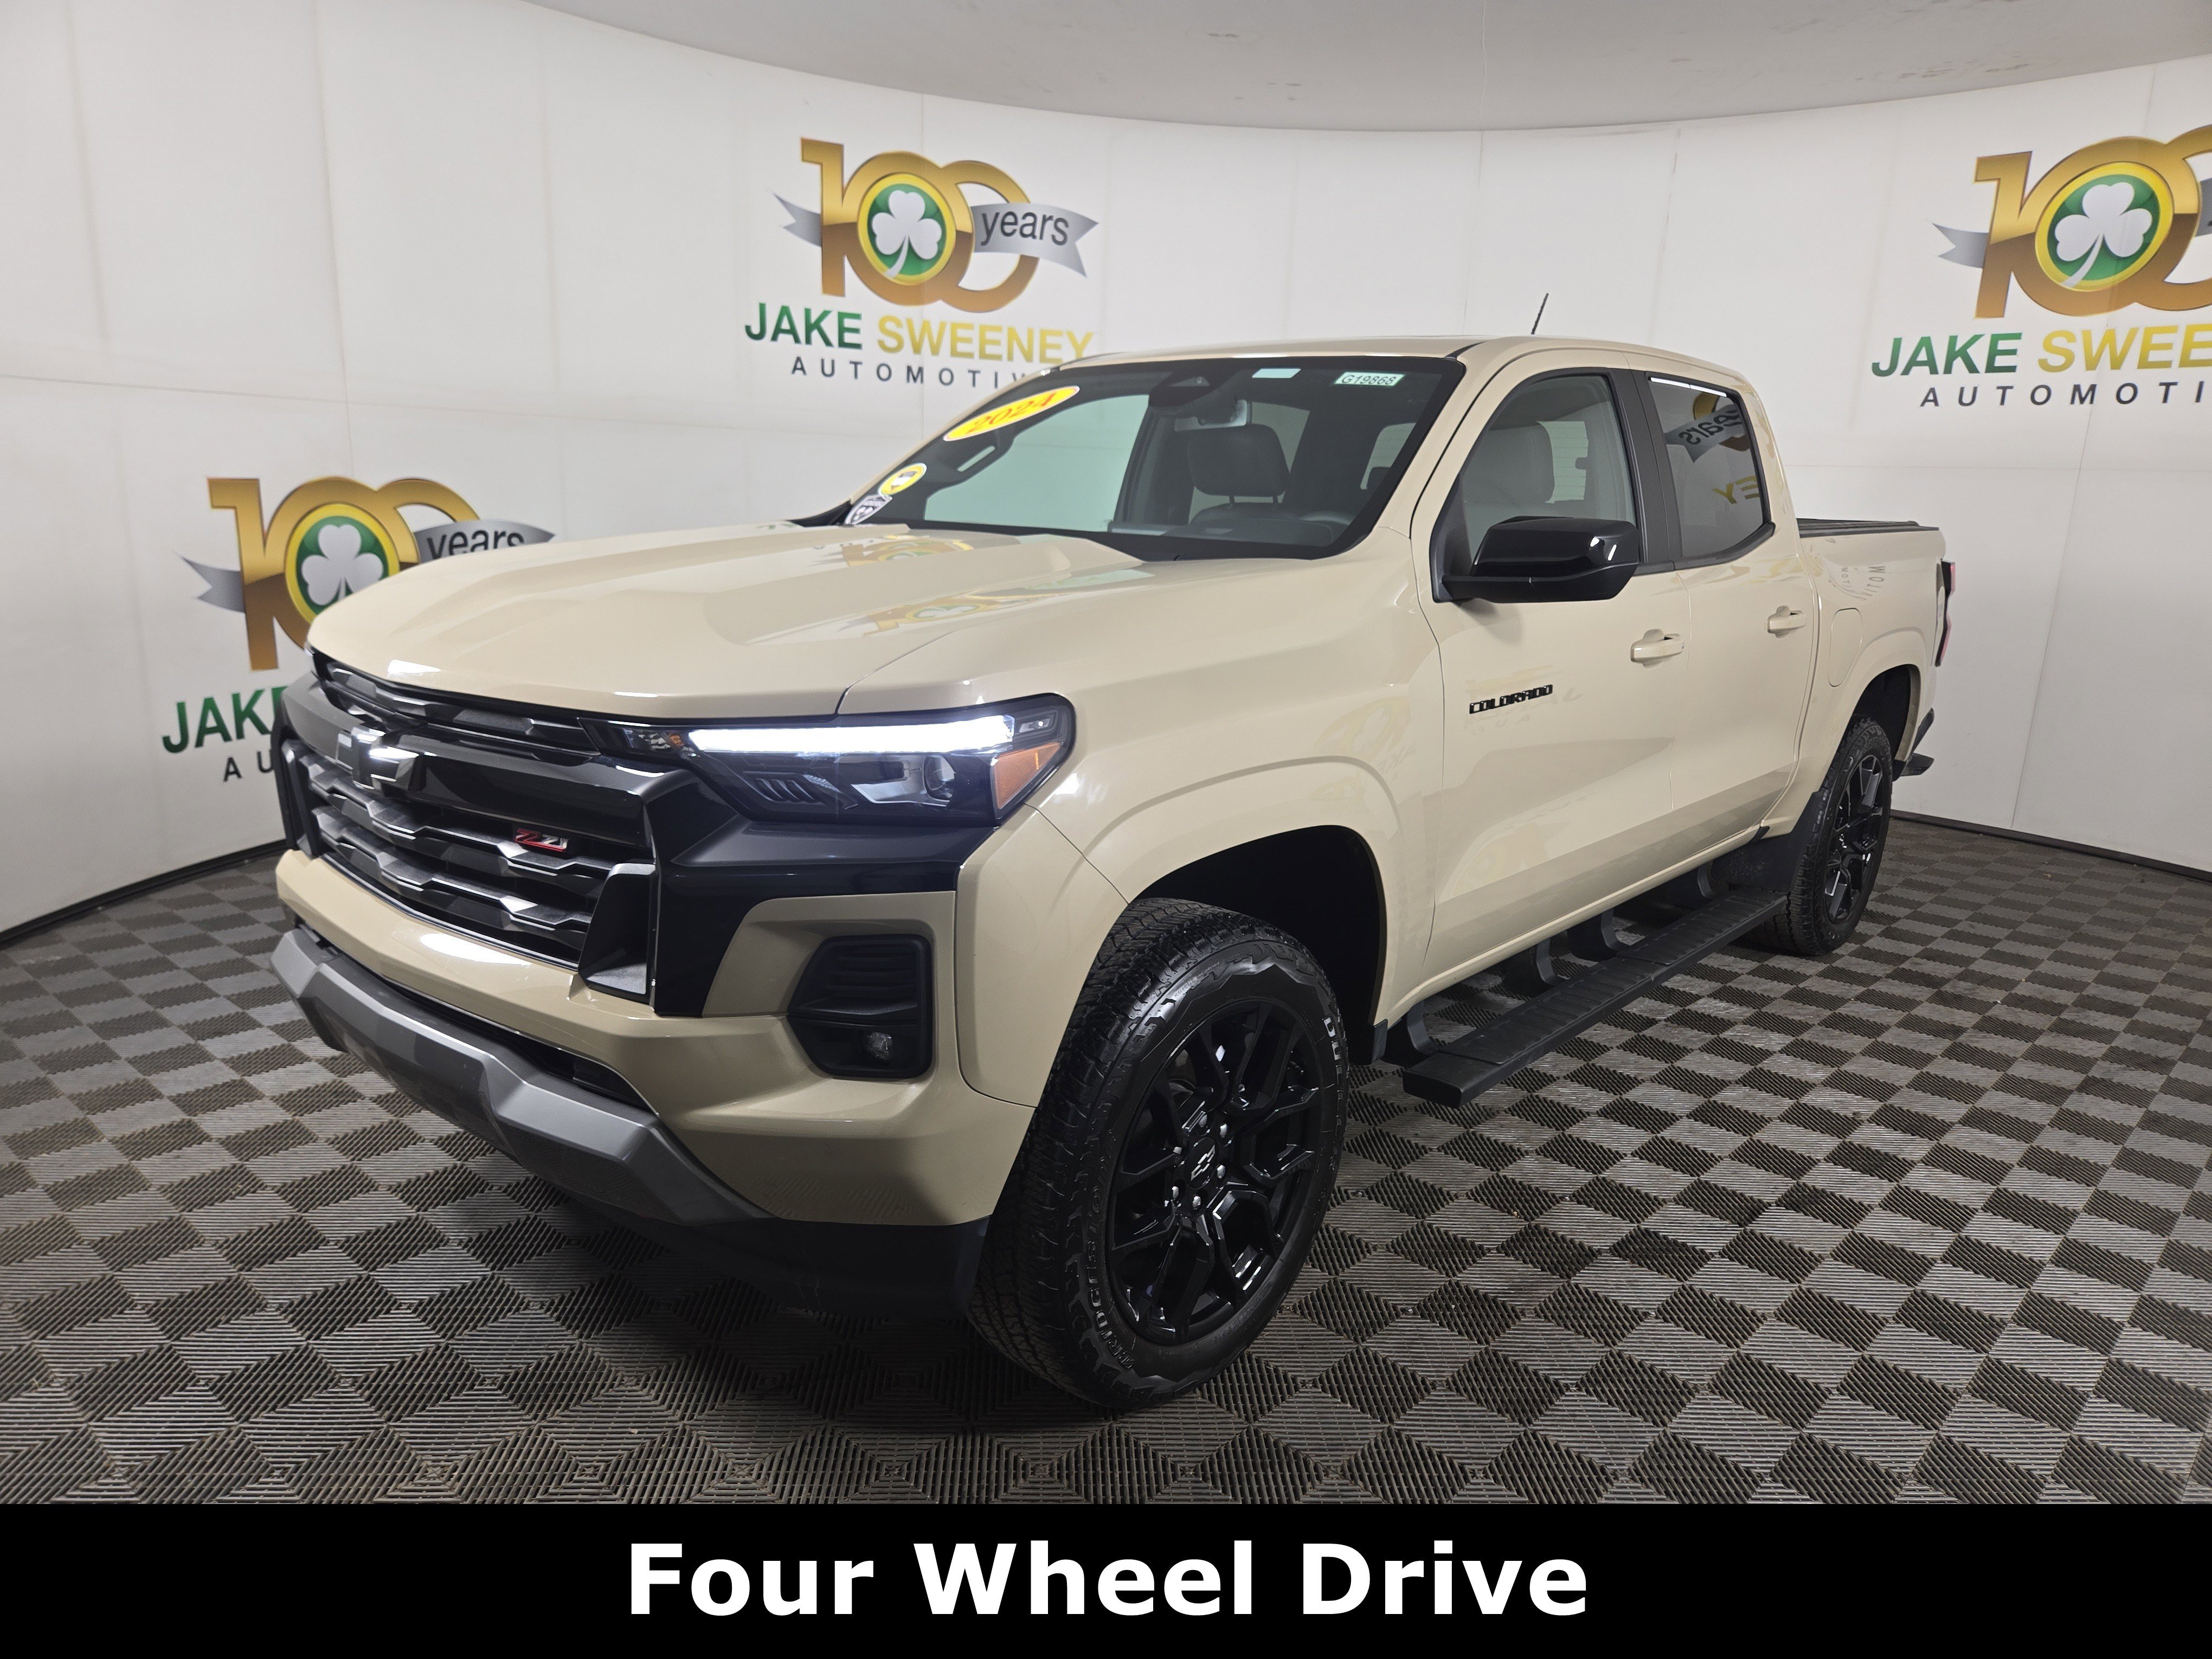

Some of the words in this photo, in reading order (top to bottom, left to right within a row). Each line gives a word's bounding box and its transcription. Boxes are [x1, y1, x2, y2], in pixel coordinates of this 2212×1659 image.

[980, 210, 1070, 247] years
[745, 302, 863, 350] JAKE
[877, 315, 1095, 364] SWEENEY
[1871, 332, 2023, 377] JAKE
[1341, 374, 1397, 385] G19868
[967, 391, 1057, 433] 2024
[1469, 684, 1553, 714] COLORADO
[515, 827, 569, 853] Z71
